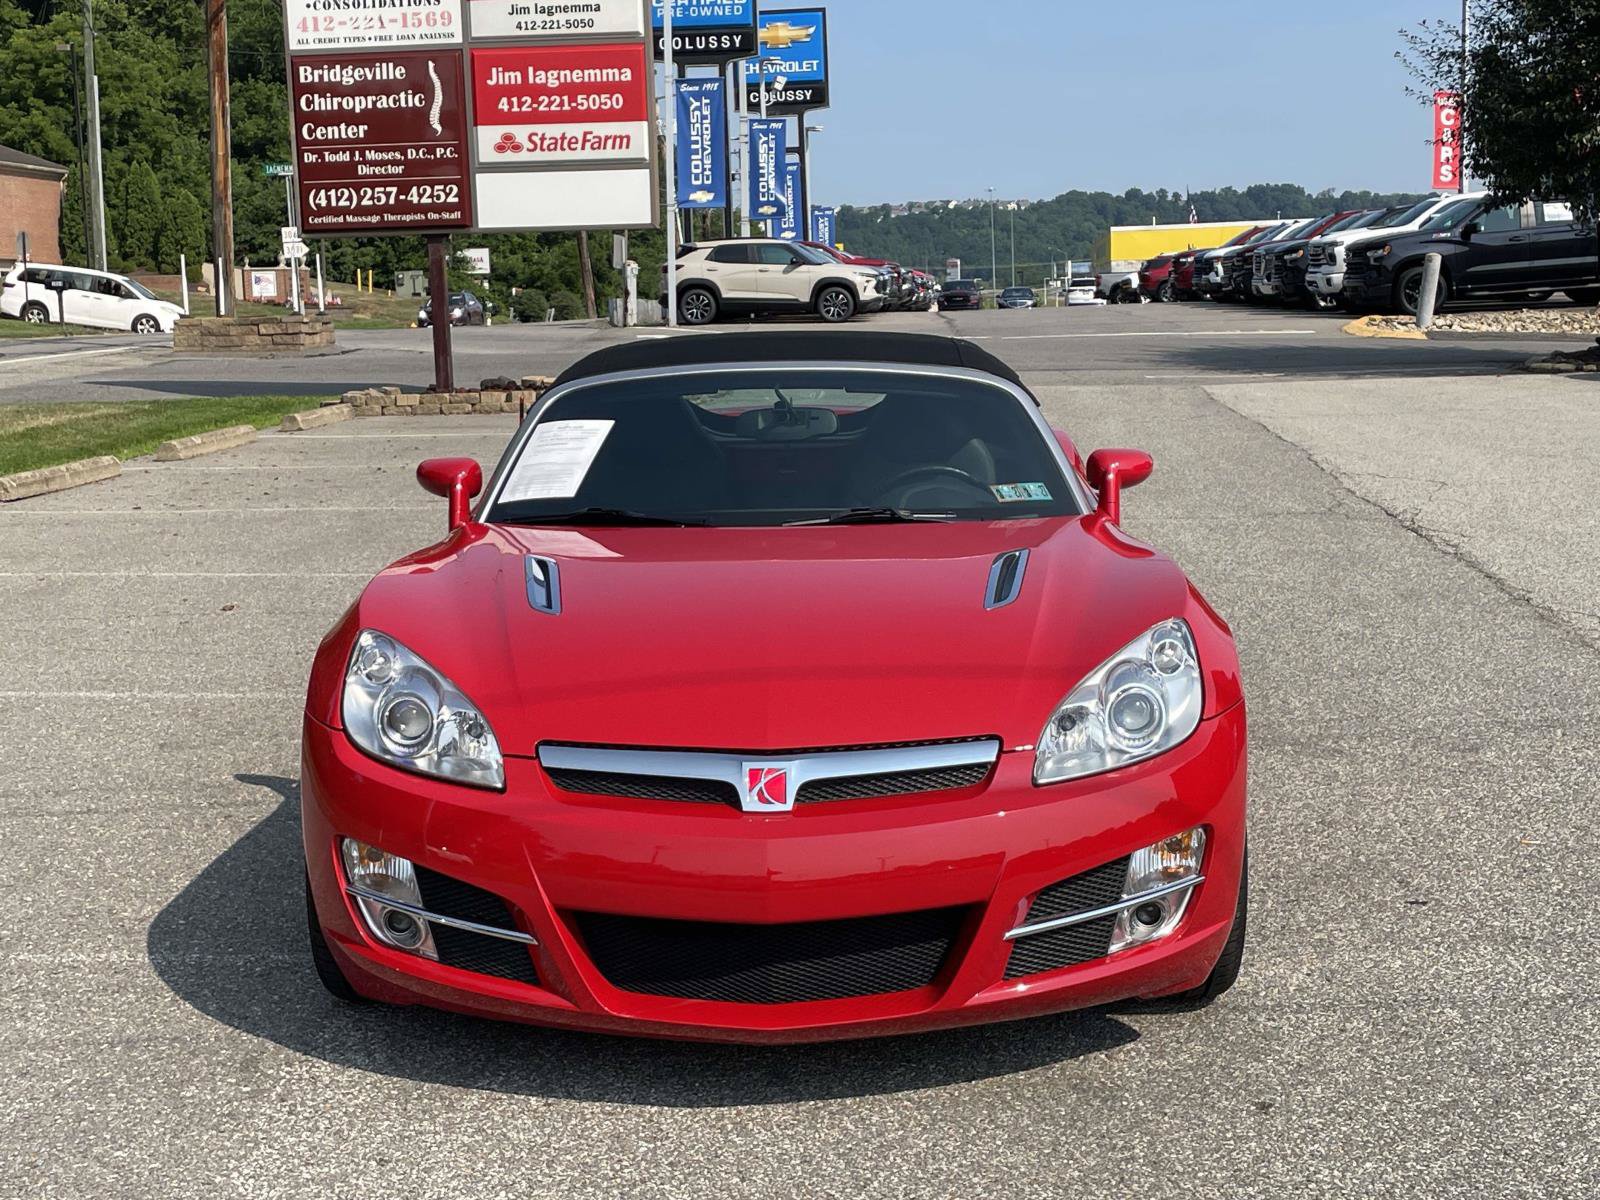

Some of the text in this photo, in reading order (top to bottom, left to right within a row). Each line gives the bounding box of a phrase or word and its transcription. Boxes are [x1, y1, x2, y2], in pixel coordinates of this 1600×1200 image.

[507, 2, 601, 17] Jim Iagnemma
[296, 10, 453, 33] 412-221-1569
[515, 18, 594, 31] 412-221-5050
[296, 31, 455, 46] ALL CREDIT TYPES FREE LOAN ANALYSIS
[298, 62, 407, 85] Bridgeville
[486, 66, 632, 88] Jim Iagnemma
[300, 89, 426, 113] Chiropractic
[498, 93, 624, 113] 412-221-5050
[301, 122, 369, 141] Center
[689, 96, 703, 186] COLUSSY
[702, 96, 712, 185] CHEVROLET
[303, 152, 322, 163] Dr.
[323, 150, 351, 162] Todd
[353, 150, 363, 162] J.
[365, 149, 405, 161] Moses,
[436, 147, 459, 158] P.C.
[357, 164, 405, 175] Director
[759, 132, 769, 202] COLUSSY
[768, 132, 776, 202] CHEVROLET
[308, 211, 461, 224] Certified Massage Therapists On-Staff
